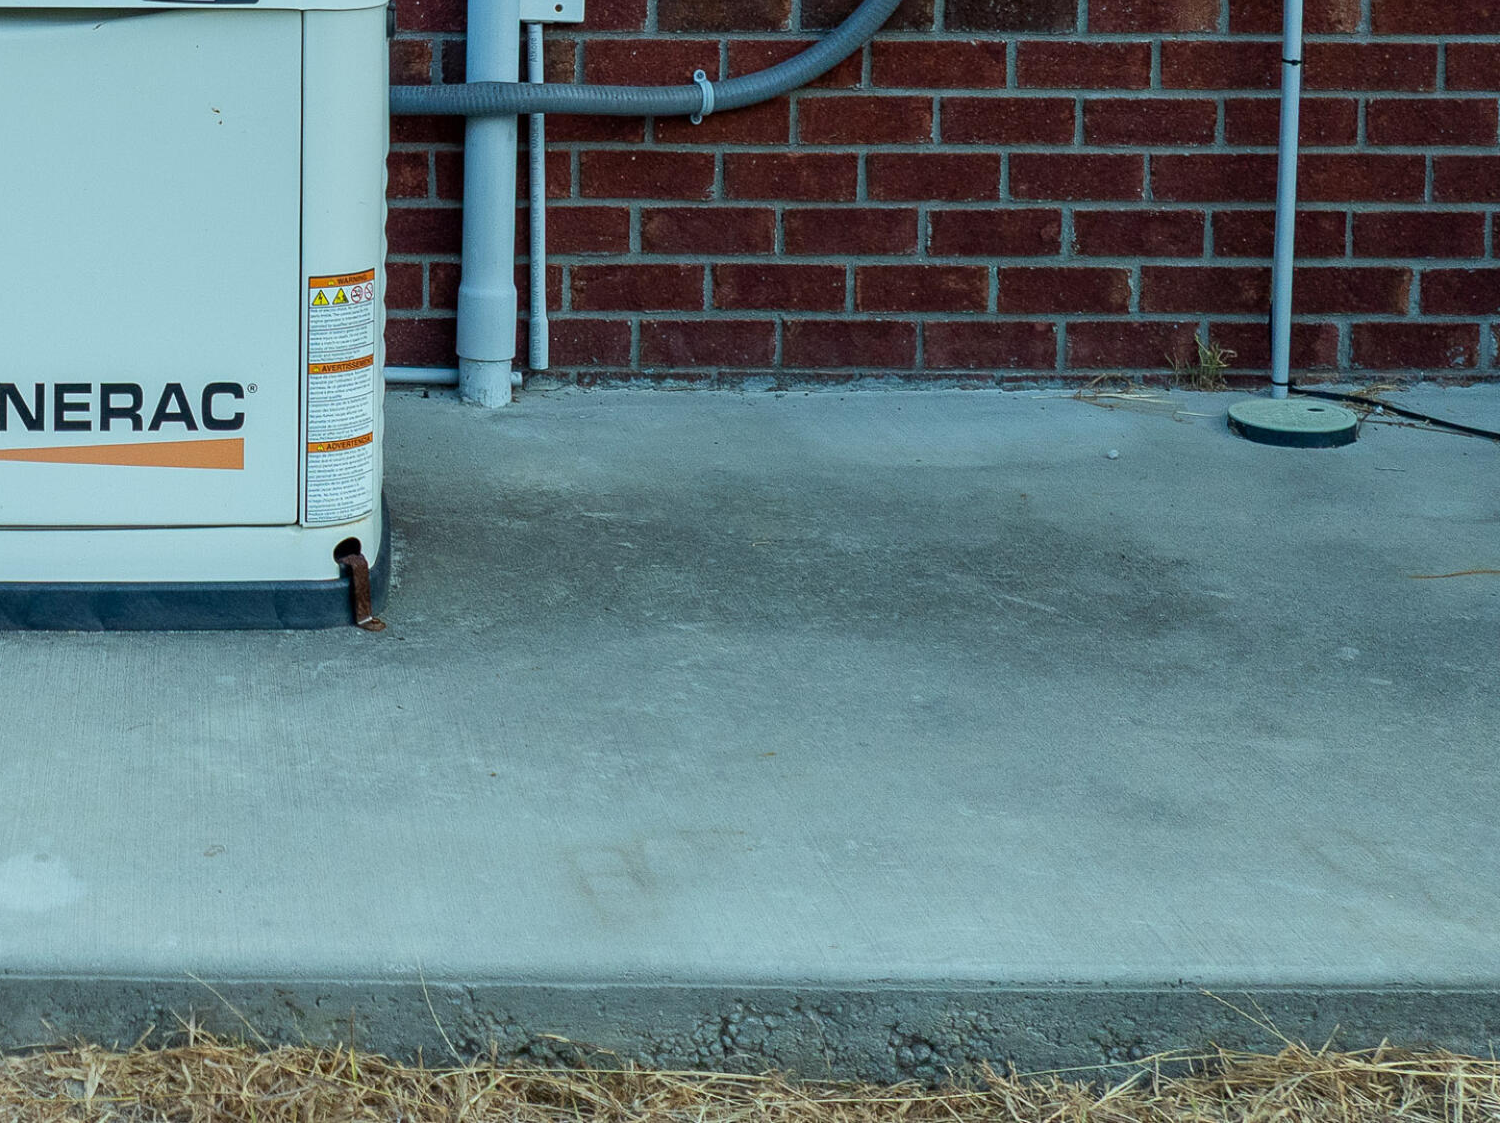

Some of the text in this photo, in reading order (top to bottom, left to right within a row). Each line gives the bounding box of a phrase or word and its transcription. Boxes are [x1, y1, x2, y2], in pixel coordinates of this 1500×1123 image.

[529, 38, 538, 63] Atkore
[336, 274, 368, 285] WARNING
[326, 437, 371, 450] ADVERTENCIA
